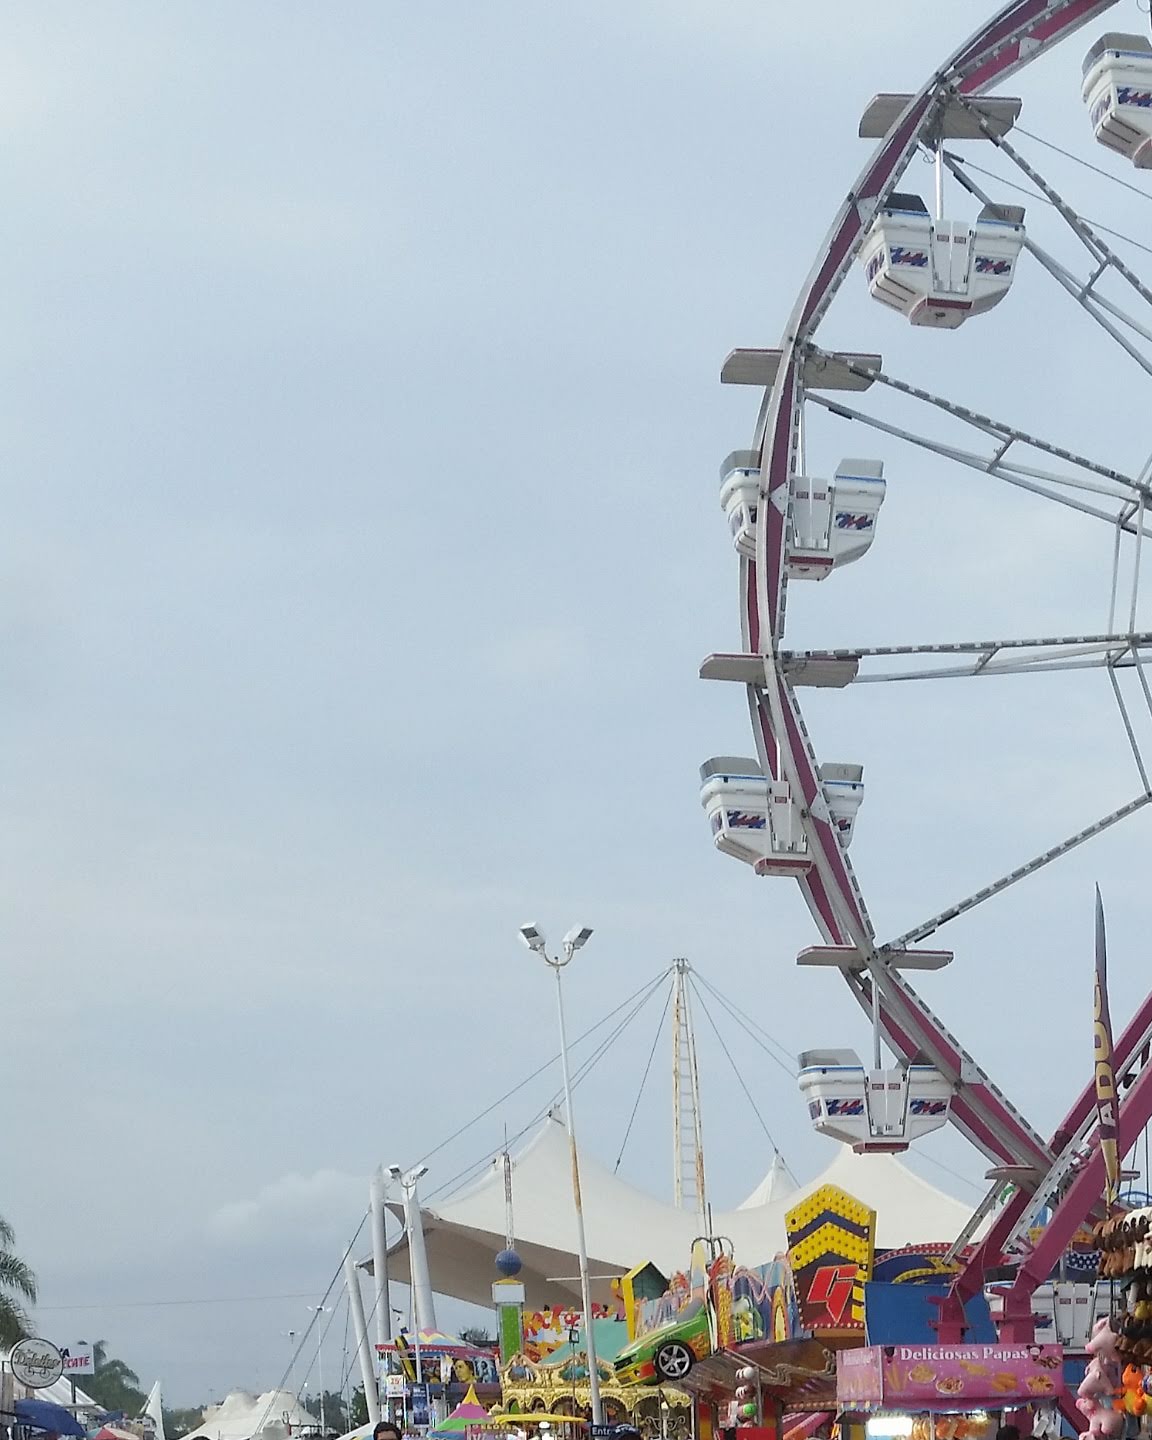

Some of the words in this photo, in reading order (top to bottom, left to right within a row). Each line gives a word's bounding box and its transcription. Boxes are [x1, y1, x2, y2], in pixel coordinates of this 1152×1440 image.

[900, 1347, 979, 1361] Deliciosas
[983, 1346, 1029, 1362] Papas
[592, 1427, 610, 1436] Entr
